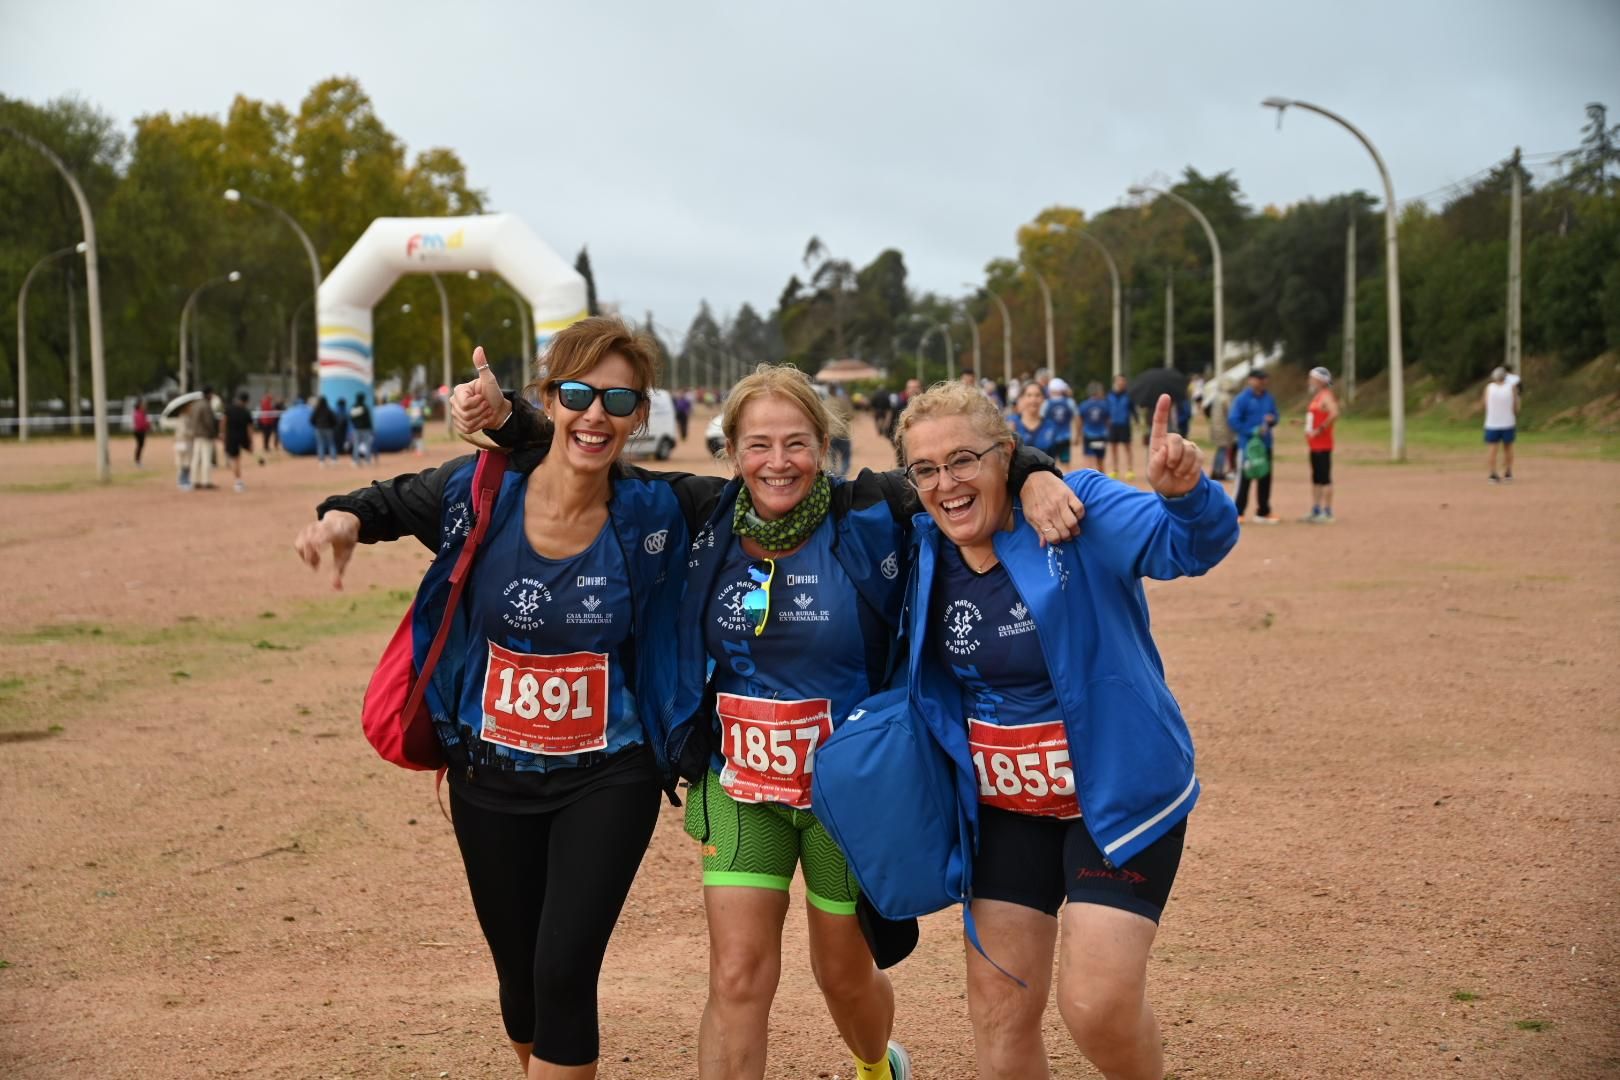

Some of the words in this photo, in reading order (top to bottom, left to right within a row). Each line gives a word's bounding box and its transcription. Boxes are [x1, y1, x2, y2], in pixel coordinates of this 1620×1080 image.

[503, 580, 519, 596] CLUB
[522, 578, 552, 602] MARATON
[718, 584, 734, 600] CLUB
[503, 613, 545, 630] BADAJOZ
[954, 599, 983, 621] MARATON
[945, 640, 981, 655] BADAJOZ
[494, 667, 593, 721] 1891
[730, 722, 820, 775] 1857
[973, 750, 1076, 797] 1855
